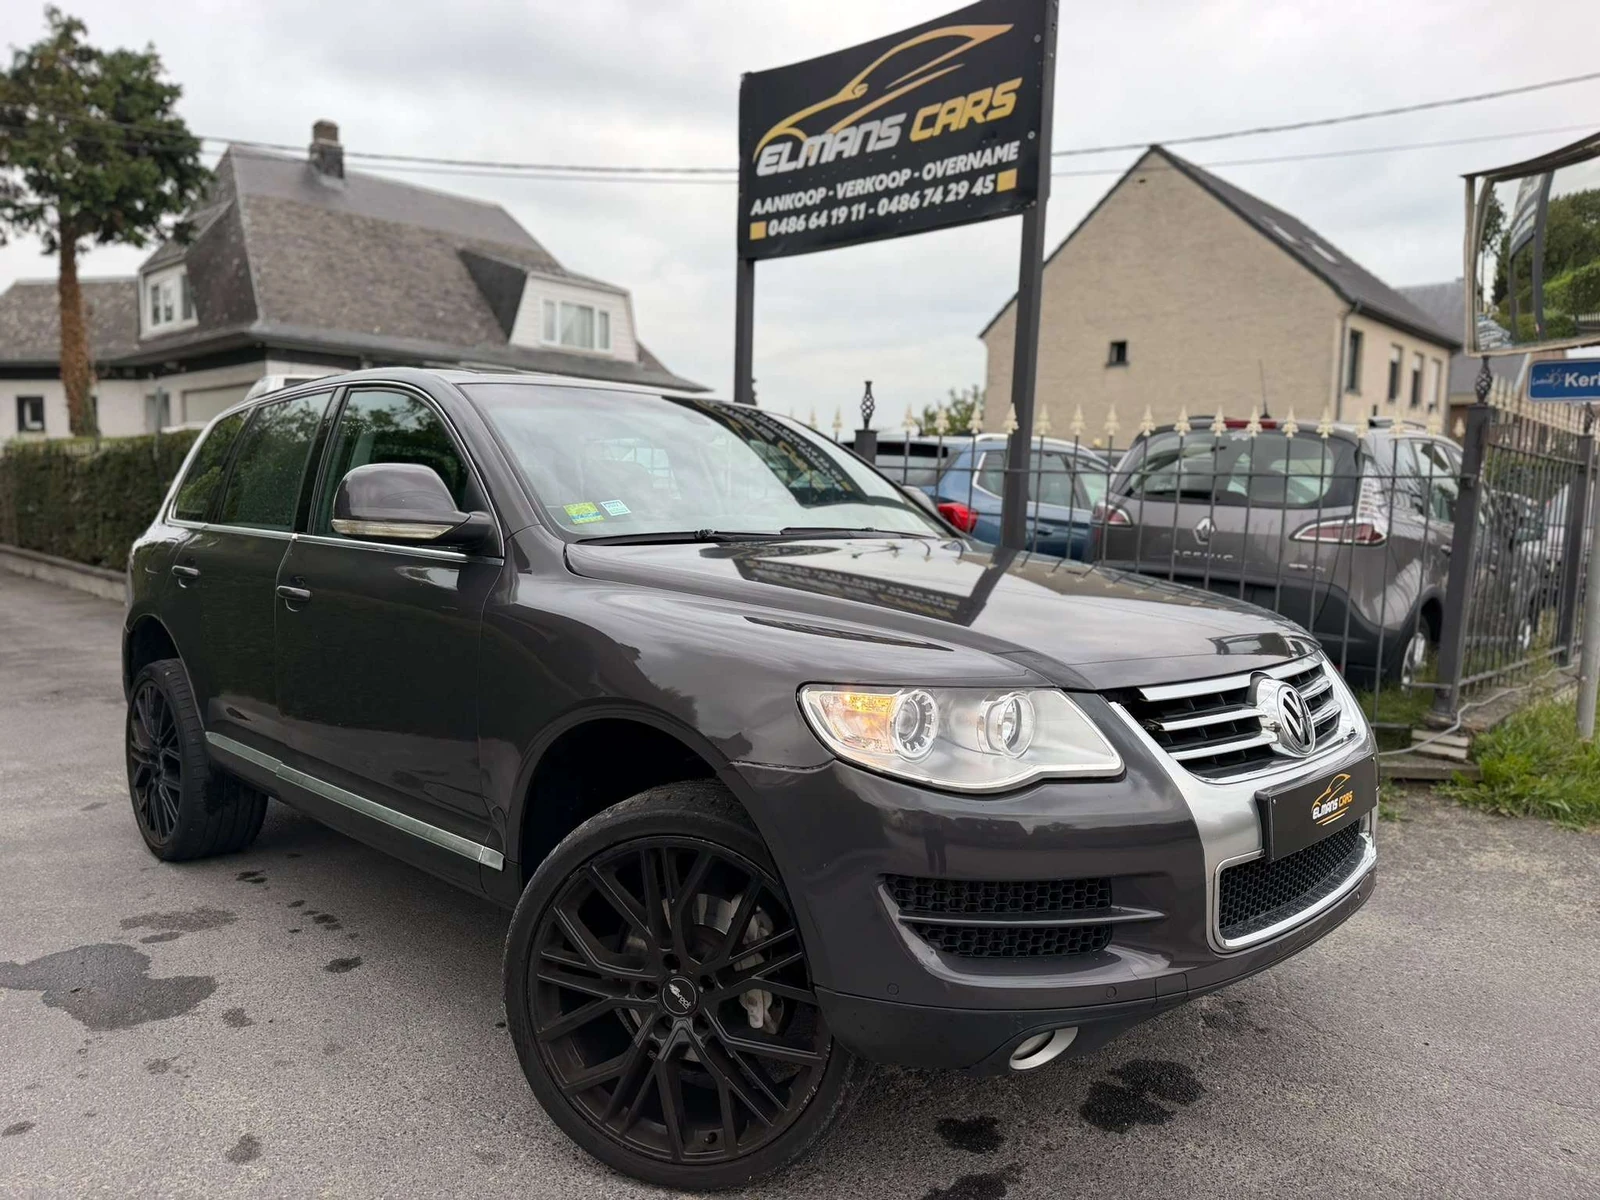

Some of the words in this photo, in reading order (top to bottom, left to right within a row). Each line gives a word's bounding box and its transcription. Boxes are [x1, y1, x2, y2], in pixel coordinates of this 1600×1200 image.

[756, 113, 907, 176] ELMANS
[909, 77, 1023, 142] CARS
[750, 187, 827, 216] AANKOOP
[836, 168, 912, 199] VERKOOP
[922, 140, 1020, 181] OVERNAME
[768, 213, 807, 236] 0486
[808, 209, 829, 229] 64
[830, 205, 849, 225] 19
[850, 202, 867, 221] 11
[877, 191, 920, 216] 0486
[921, 185, 944, 207] 74
[945, 180, 970, 202] 29
[970, 173, 996, 196] 45
